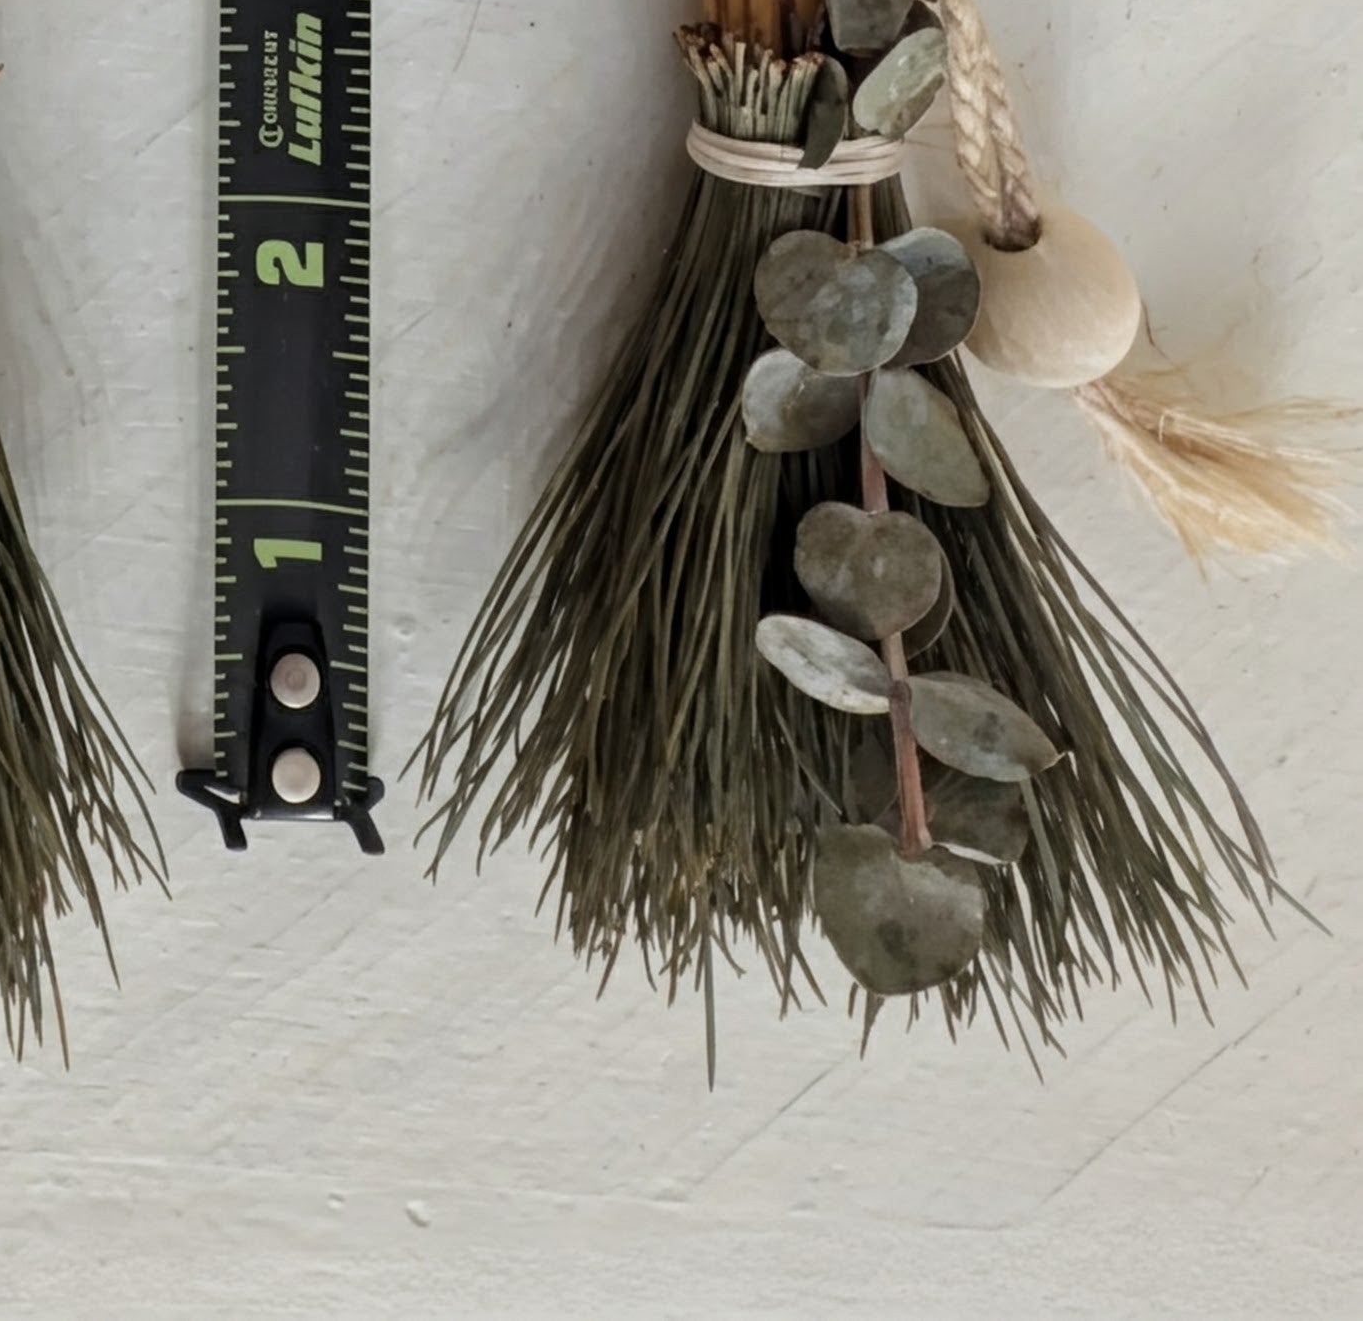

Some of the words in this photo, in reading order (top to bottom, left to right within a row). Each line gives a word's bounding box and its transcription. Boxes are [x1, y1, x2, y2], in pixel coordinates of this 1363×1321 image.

[288, 12, 323, 166] Lufkin
[253, 239, 325, 288] 2
[253, 538, 323, 569] 1
